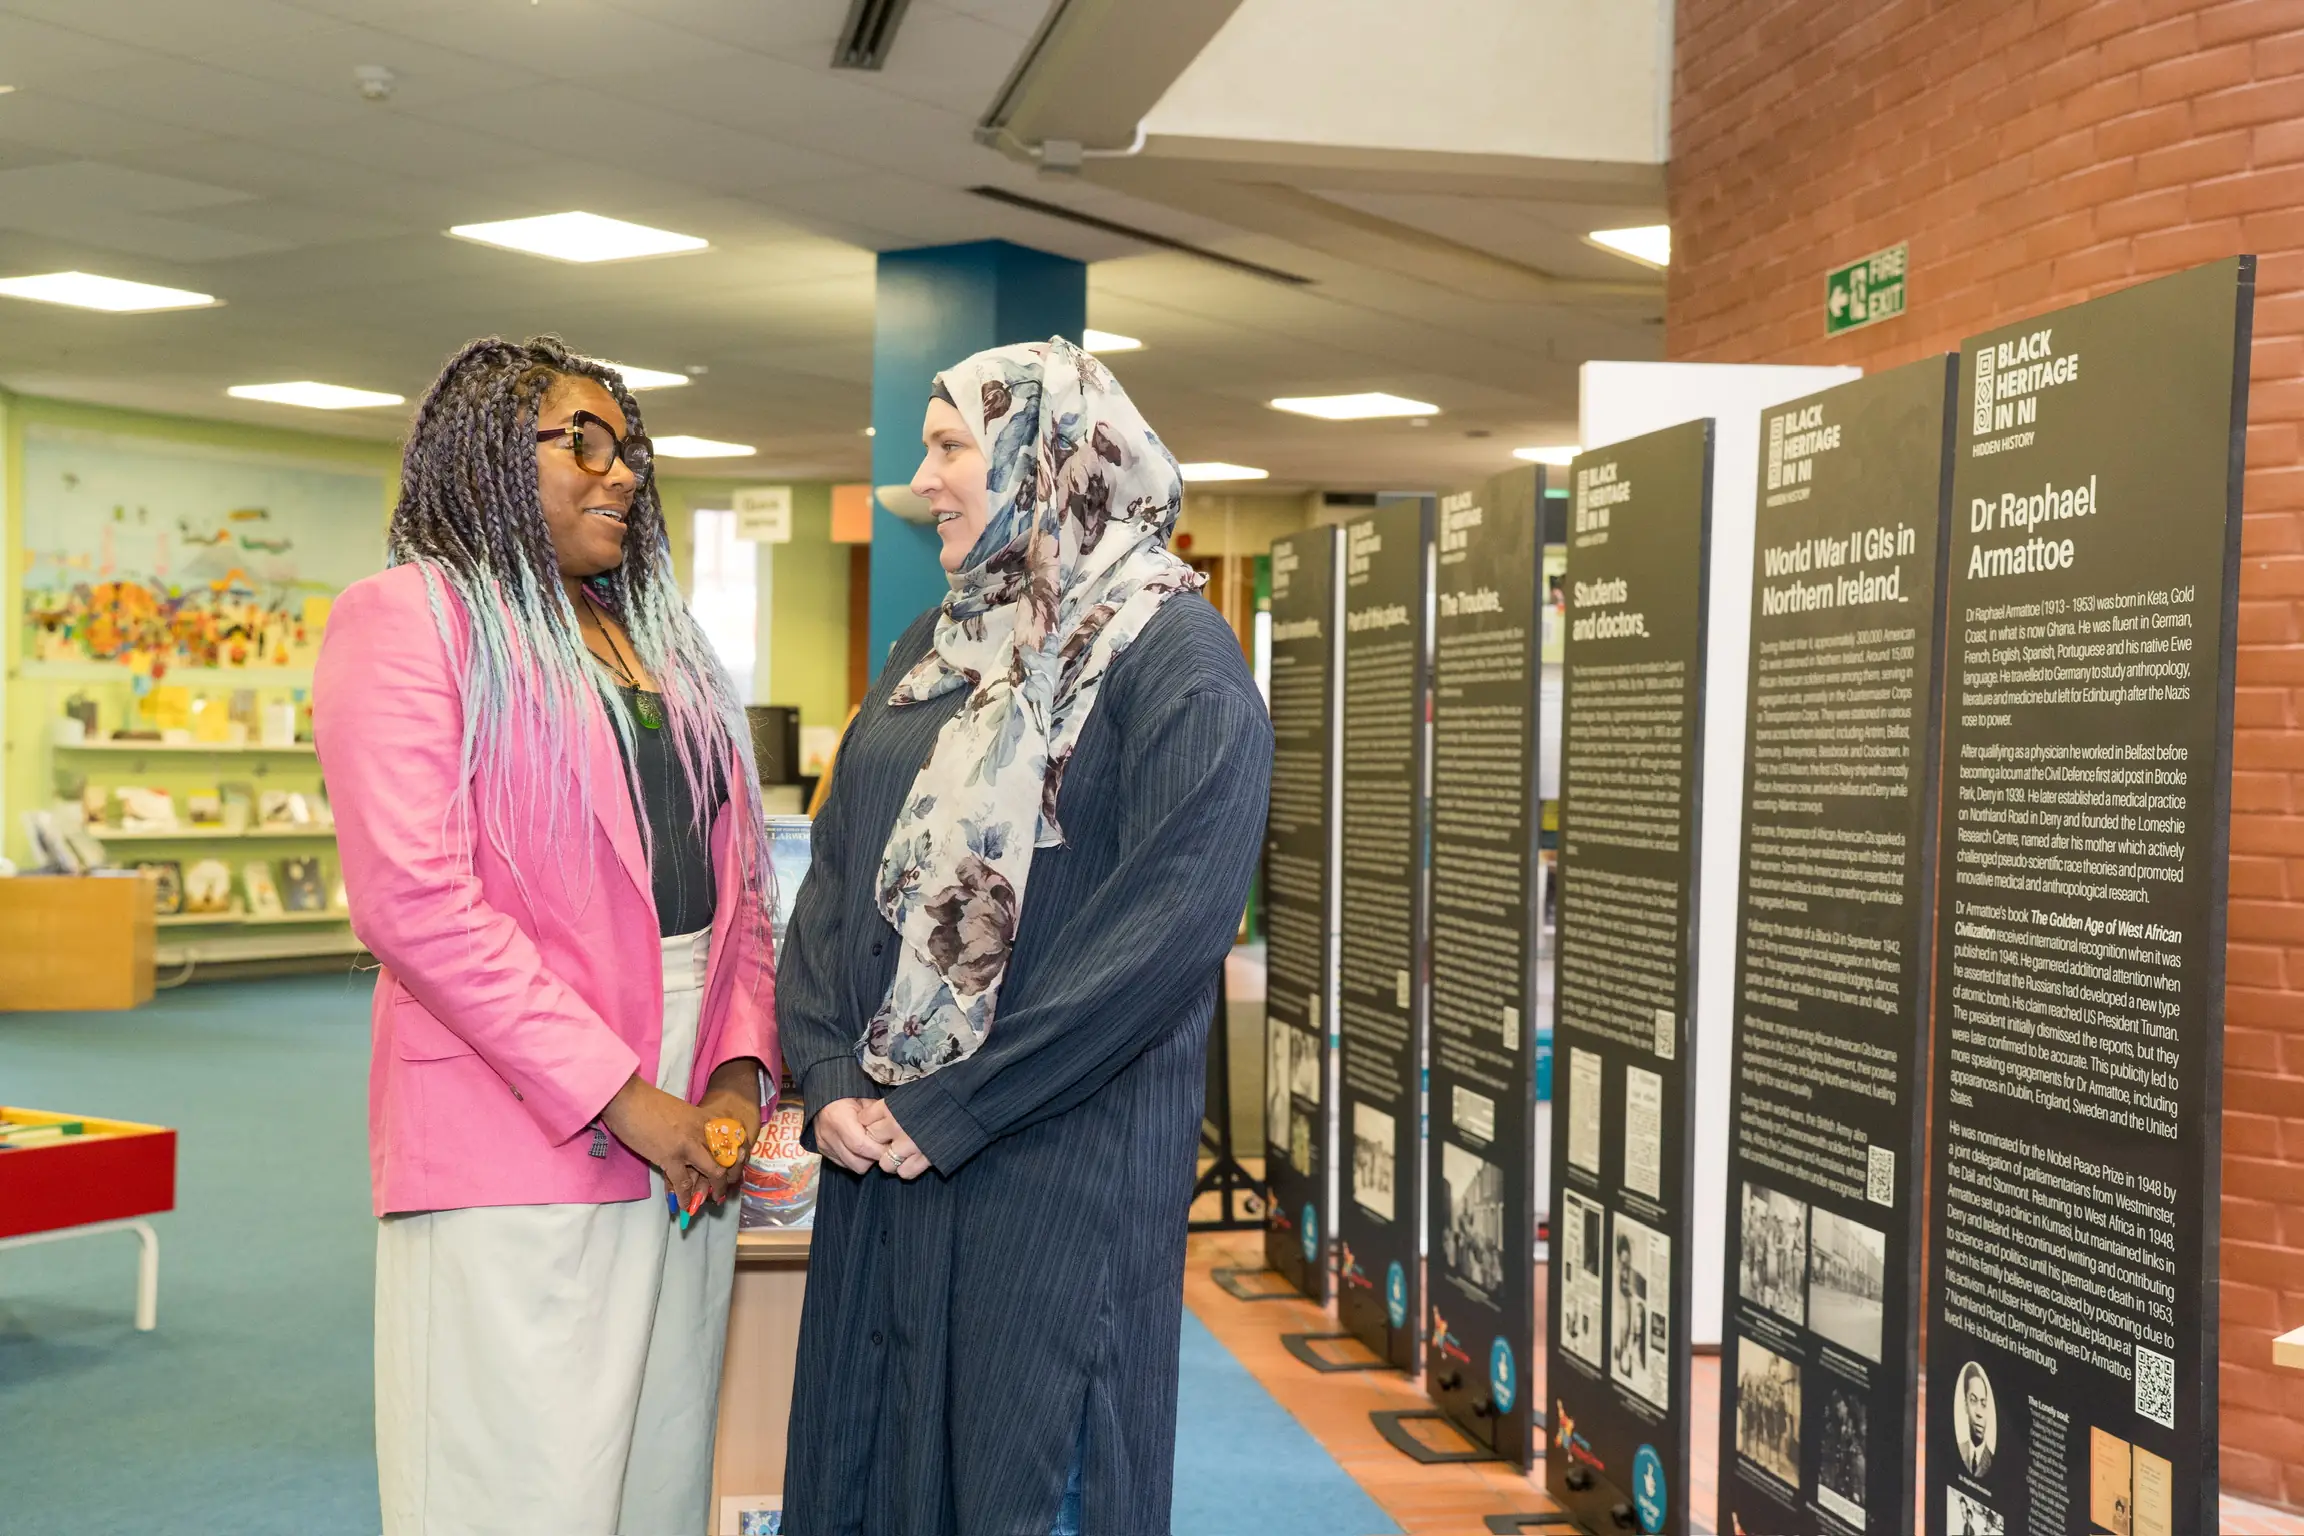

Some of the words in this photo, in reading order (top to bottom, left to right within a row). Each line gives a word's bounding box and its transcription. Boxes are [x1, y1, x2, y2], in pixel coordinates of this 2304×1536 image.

[1870, 250, 1904, 285] FIRE
[1869, 283, 1903, 319] EXIT
[1997, 329, 2053, 369] BLACK
[1996, 354, 2078, 399] HERITAGE
[1785, 404, 1823, 434] BLACK
[1995, 403, 2013, 431] IN
[2017, 397, 2037, 425] NI
[1784, 425, 1841, 460] HERITAGE
[1972, 438, 2000, 457] HIDDEN
[2002, 431, 2035, 452] HISTORY
[1589, 462, 1617, 487] BLACK
[1783, 463, 1796, 486] IN
[1798, 458, 1812, 483] NI
[1971, 498, 1996, 533] Dr
[2000, 474, 2097, 534] Raphael
[1764, 539, 1811, 578] World
[1814, 536, 1849, 570] War
[1850, 532, 1861, 563] II
[1864, 527, 1894, 563] GIs
[1897, 522, 1915, 556] in
[1967, 538, 2074, 579] Armattoe
[1574, 577, 1627, 608] Students
[1762, 579, 1834, 616] Northern
[1965, 608, 1975, 622] Dr
[1975, 604, 2005, 624] Raphael
[2004, 603, 2041, 619] Armattoe
[2040, 598, 2065, 616] (1913
[2072, 594, 2096, 612] 1953)
[2096, 596, 2114, 610] was
[2114, 593, 2136, 609] born
[2137, 591, 2146, 606] in
[2147, 590, 2169, 606] Keta,
[2170, 584, 2195, 604] Gold
[1573, 612, 1596, 640] and
[1884, 628, 1915, 642] American
[1989, 627, 1997, 641] in
[1997, 624, 2018, 640] what
[2018, 624, 2026, 640] is
[2026, 625, 2045, 639] now
[2047, 621, 2076, 637] Ghana.
[2078, 619, 2091, 634] He
[2092, 619, 2111, 633] was
[2112, 615, 2139, 631] fluent
[2140, 614, 2149, 629] in
[2151, 612, 2193, 629] German,
[1865, 648, 1890, 662] Around
[1958, 809, 1969, 821] on
[1969, 807, 2007, 823] Northland
[2007, 808, 2029, 824] Road
[2031, 812, 2038, 824] in
[2039, 810, 2062, 830] Derry
[2063, 812, 2080, 827] and
[2081, 811, 2119, 830] founded
[2120, 814, 2136, 831] the
[2138, 816, 2185, 834] Lomeshie
[1957, 826, 1991, 843] Research
[1992, 829, 2020, 848] Centre,
[2021, 833, 2050, 848] named
[2050, 832, 2070, 849] after
[2070, 834, 2083, 851] his
[2084, 836, 2117, 853] mother
[2117, 838, 2146, 855] which
[2147, 841, 2185, 862] actively
[1956, 869, 1994, 887] innovative
[1994, 873, 2025, 890] medical
[2024, 876, 2042, 892] and
[2041, 877, 2108, 901] anthropological
[2108, 886, 2150, 903] research.
[1955, 900, 1965, 914] Dr
[1966, 901, 2007, 920] Armattoe's
[2007, 906, 2029, 923] book
[2030, 909, 2048, 926] The
[2048, 911, 2083, 930] Golden
[2083, 916, 2105, 936] Age
[2105, 918, 2117, 935] of
[2118, 920, 2144, 939] West
[2143, 923, 2182, 944] African
[1952, 1004, 1968, 1021] The
[1968, 1010, 2006, 1029] president
[2007, 1015, 2036, 1039] initially
[2036, 1021, 2081, 1045] dismissed
[2082, 1031, 2098, 1049] the
[2099, 1037, 2134, 1058] reports,
[2137, 1041, 2154, 1061] but
[2156, 1046, 2180, 1069] they
[1950, 1048, 1970, 1064] more
[1970, 1053, 2005, 1076] speaking
[2006, 1062, 2062, 1087] engagements
[2063, 1071, 2075, 1089] for
[2076, 1075, 2088, 1092] Dr
[2088, 1079, 2131, 1105] Armattoe,
[2133, 1089, 2178, 1119] including
[1950, 1069, 1998, 1093] appearances
[1998, 1079, 2006, 1095] in
[2006, 1081, 2034, 1104] Dublin,
[2035, 1088, 2071, 1113] England,
[2072, 1098, 2109, 1121] Sweden
[2109, 1110, 2128, 1126] and
[2128, 1112, 2145, 1131] the
[2145, 1116, 2178, 1139] United
[1949, 1119, 1960, 1136] He
[1961, 1125, 1976, 1141] was
[1976, 1130, 2018, 1153] nominated
[2018, 1138, 2031, 1156] for
[2031, 1143, 2046, 1161] the
[2046, 1148, 2072, 1170] Nobel
[2073, 1155, 2101, 1178] Peace
[2102, 1164, 2124, 1185] Prize
[2125, 1171, 2135, 1188] in
[2137, 1175, 2162, 1196] 1948
[2163, 1181, 2177, 1204] by
[1948, 1143, 1954, 1155] a
[1953, 1142, 1971, 1160] joint
[1971, 1147, 2012, 1173] delegation
[2012, 1160, 2022, 1176] of
[2022, 1166, 2091, 1199] parliamentarians
[2092, 1184, 2113, 1206] from
[2115, 1192, 2176, 1228] Westminster,
